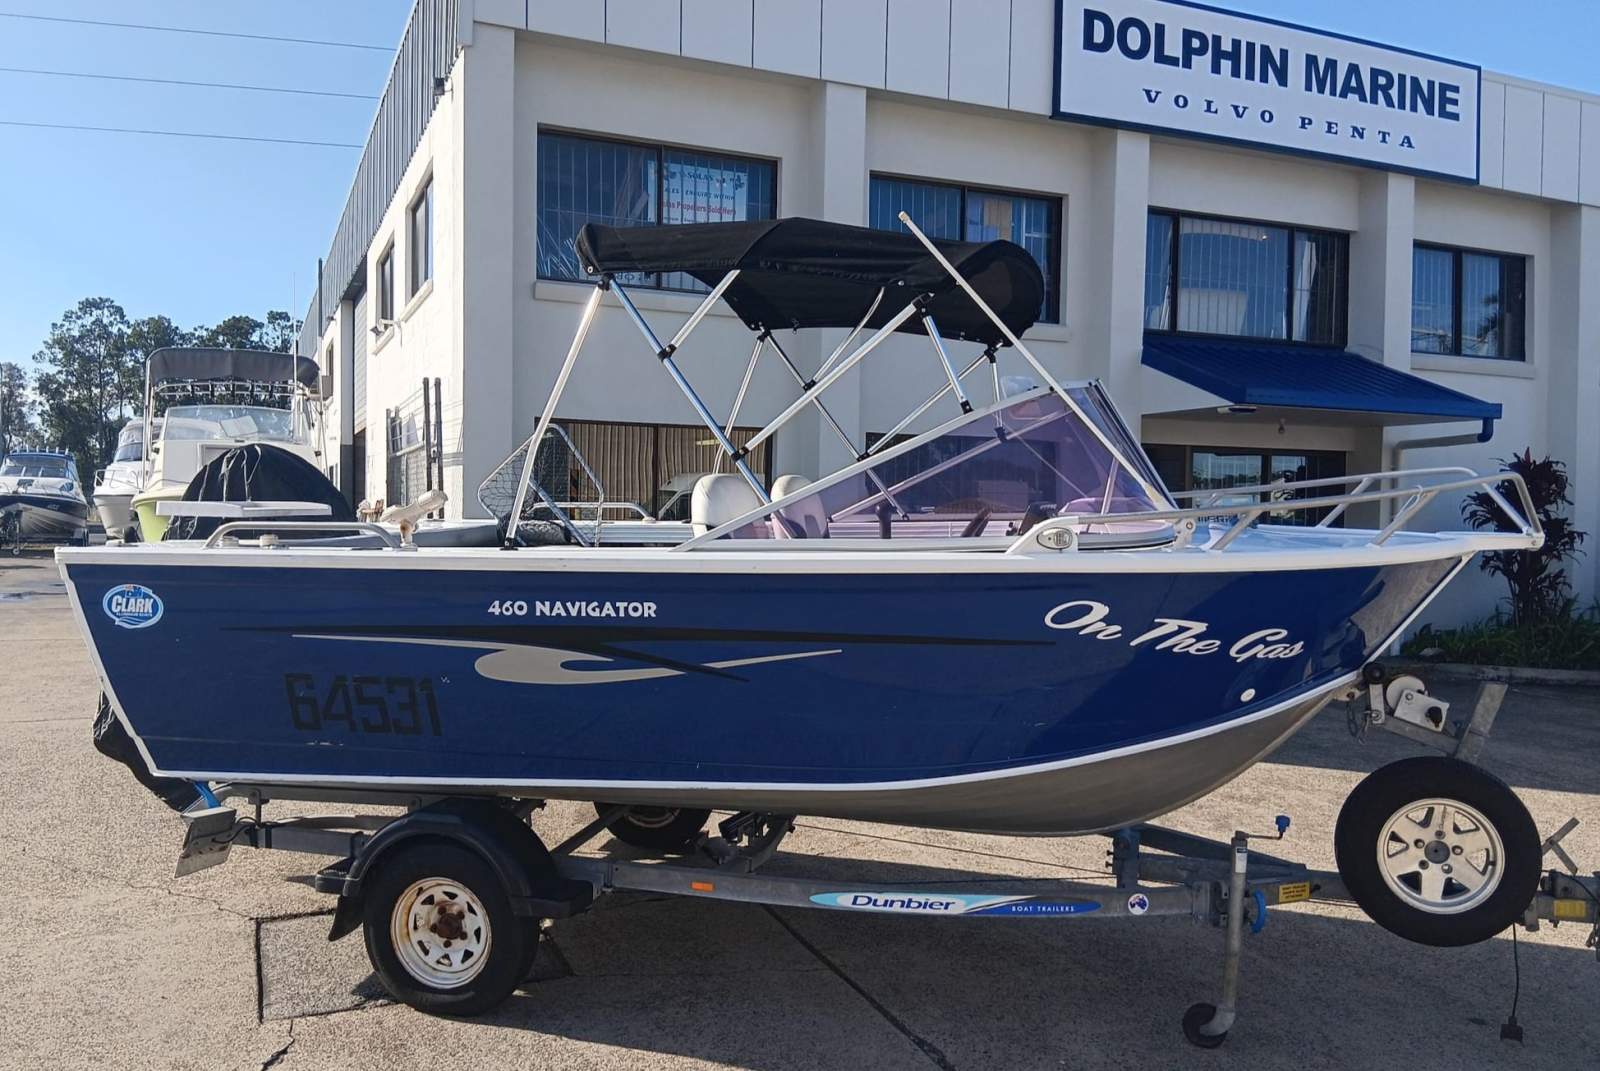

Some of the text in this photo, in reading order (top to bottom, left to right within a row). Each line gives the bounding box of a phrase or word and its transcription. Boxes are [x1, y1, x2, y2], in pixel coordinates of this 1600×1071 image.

[1082, 8, 1461, 122] DOLPHIN MARINE
[1142, 88, 1416, 149] VOLVO PENTA
[111, 595, 153, 613] CLARK
[487, 600, 657, 618] 460 NAVIGATOR
[1044, 600, 1304, 662] On The Gas
[284, 673, 442, 737] 64531
[851, 895, 956, 910] Dunbier
